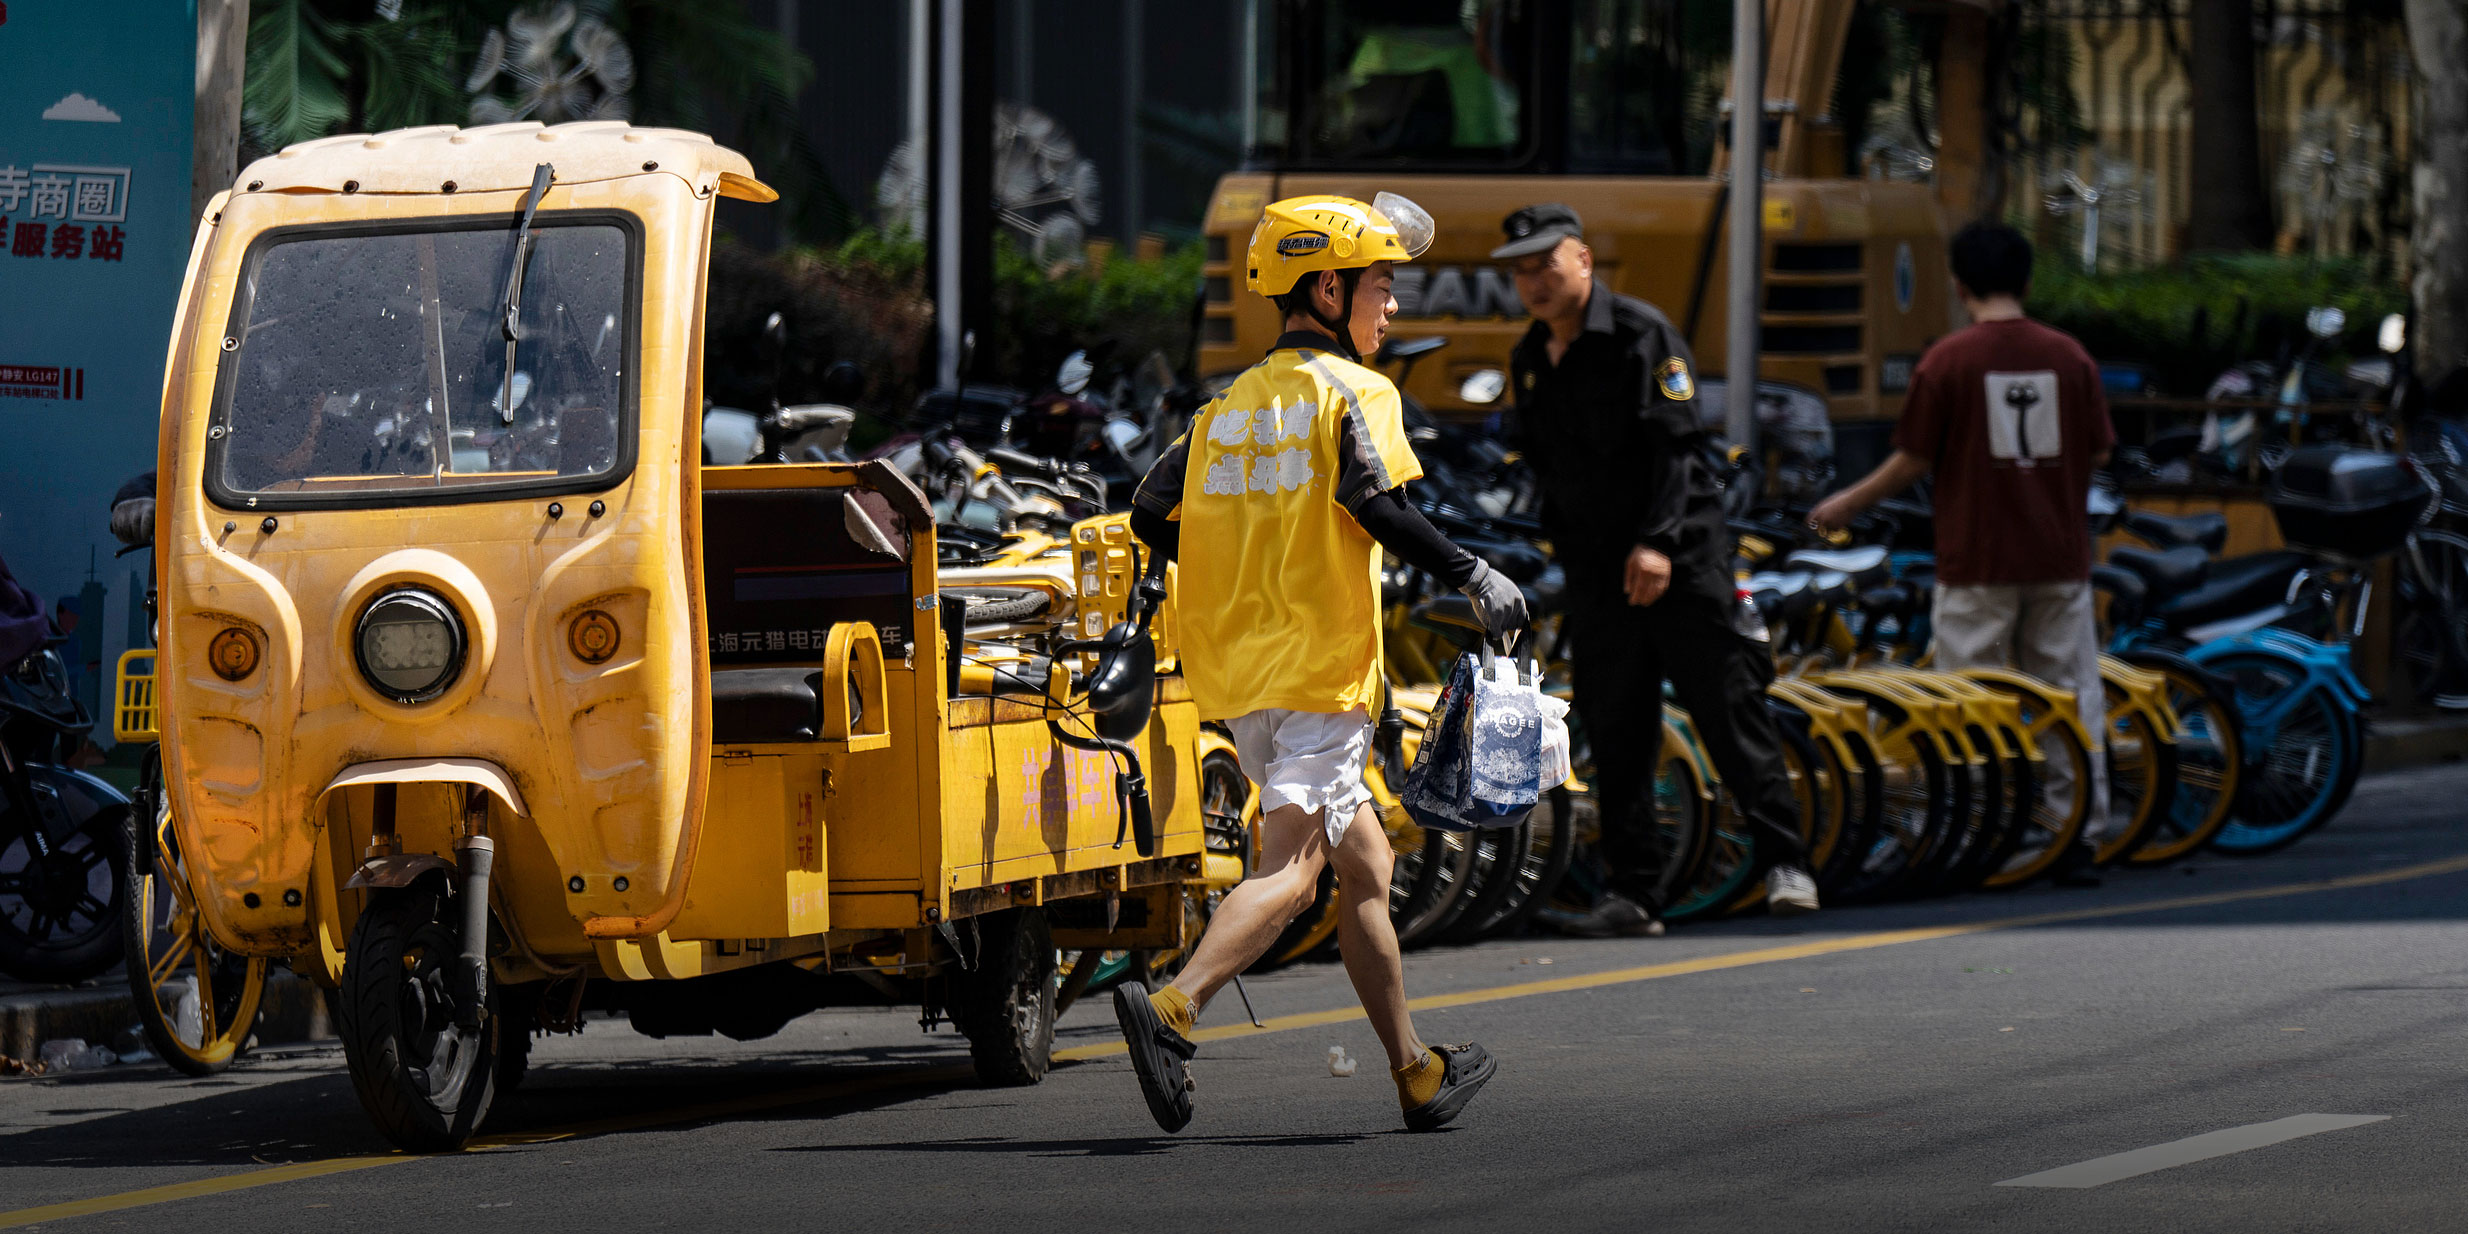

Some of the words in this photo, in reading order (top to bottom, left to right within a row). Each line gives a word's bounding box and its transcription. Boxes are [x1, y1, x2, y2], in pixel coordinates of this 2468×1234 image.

[26, 369, 58, 383] LG147
[708, 626, 902, 653] 海元猎电动车
[34, 831, 50, 856] AIMA
